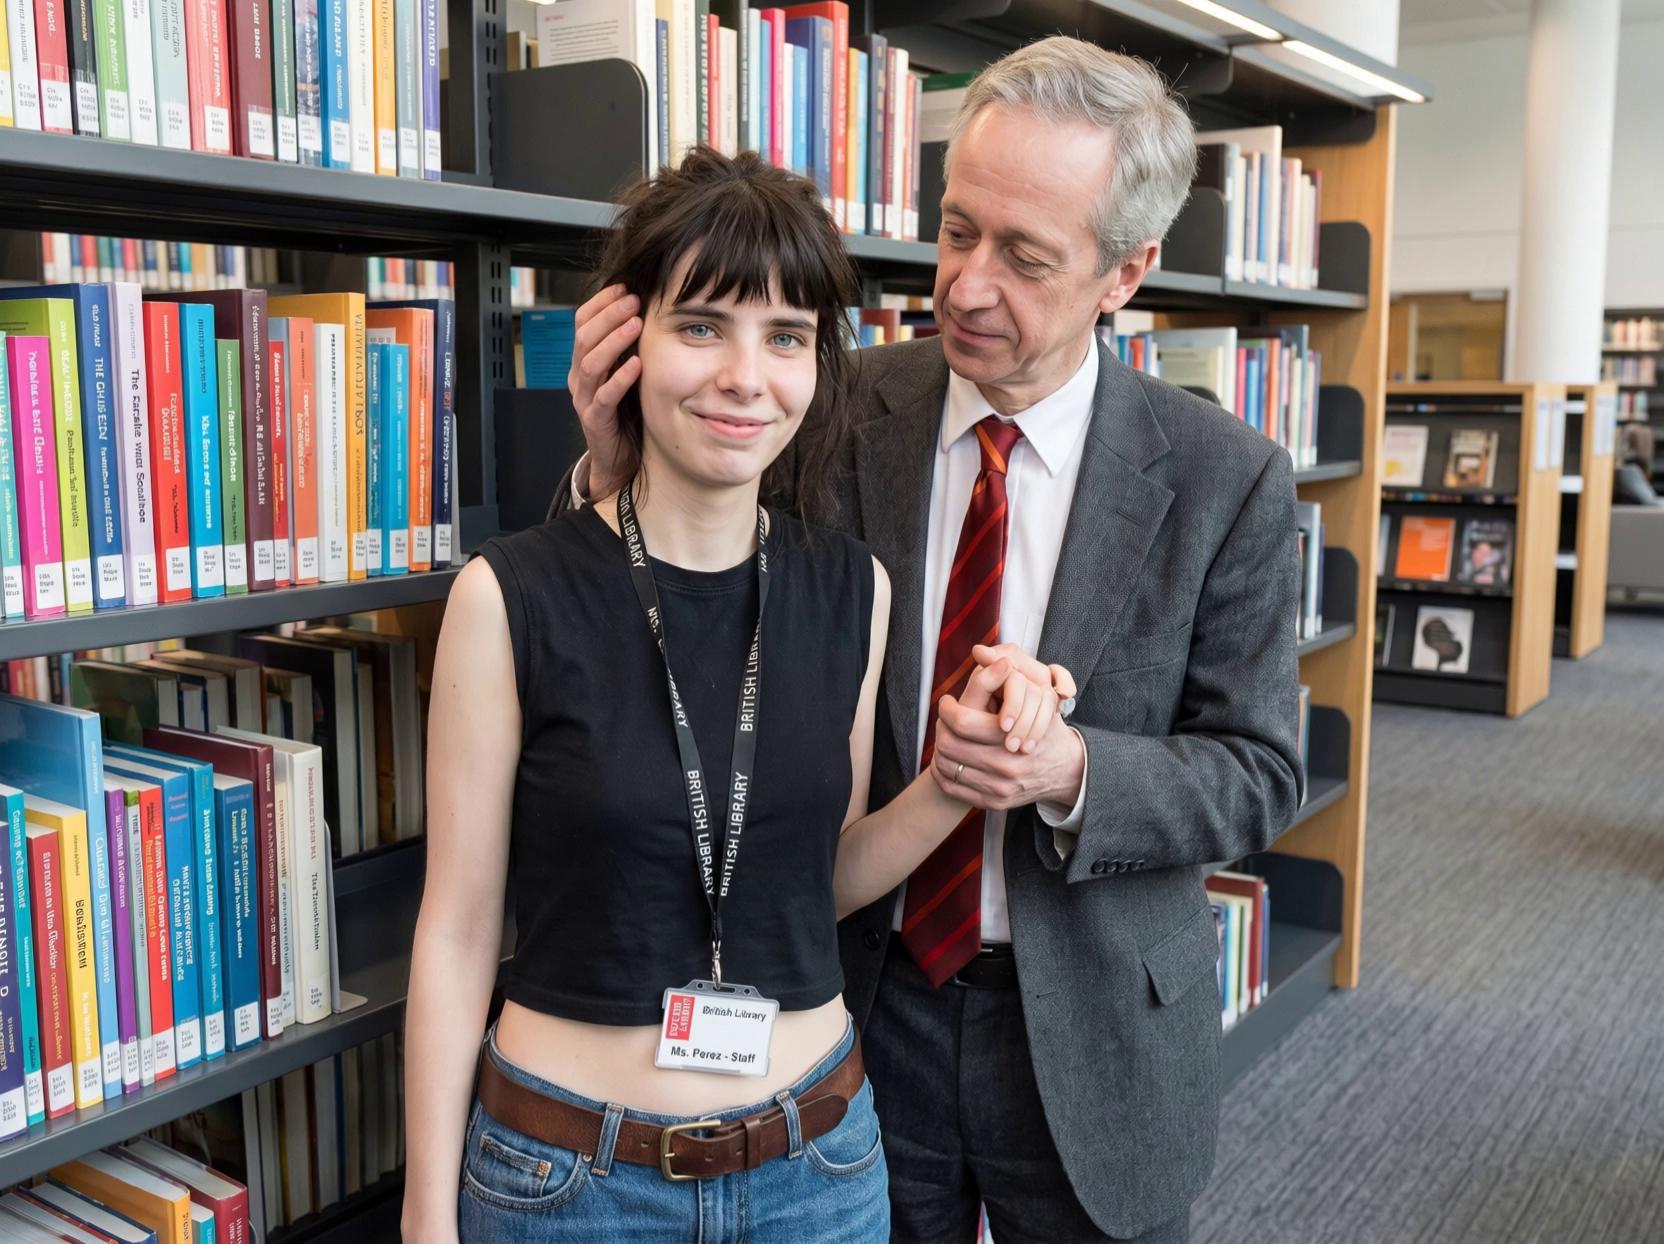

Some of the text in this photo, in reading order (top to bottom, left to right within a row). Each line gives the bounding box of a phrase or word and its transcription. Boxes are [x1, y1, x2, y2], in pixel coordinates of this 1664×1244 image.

[622, 514, 646, 567] LIBRARY
[740, 677, 757, 732] BRITISH
[731, 772, 748, 835] LIBRARY
[688, 771, 715, 894] BRITISH LIBRARY
[670, 1046, 689, 1058] Ms.
[692, 1048, 722, 1061] Perez
[730, 1052, 756, 1063] Staff
